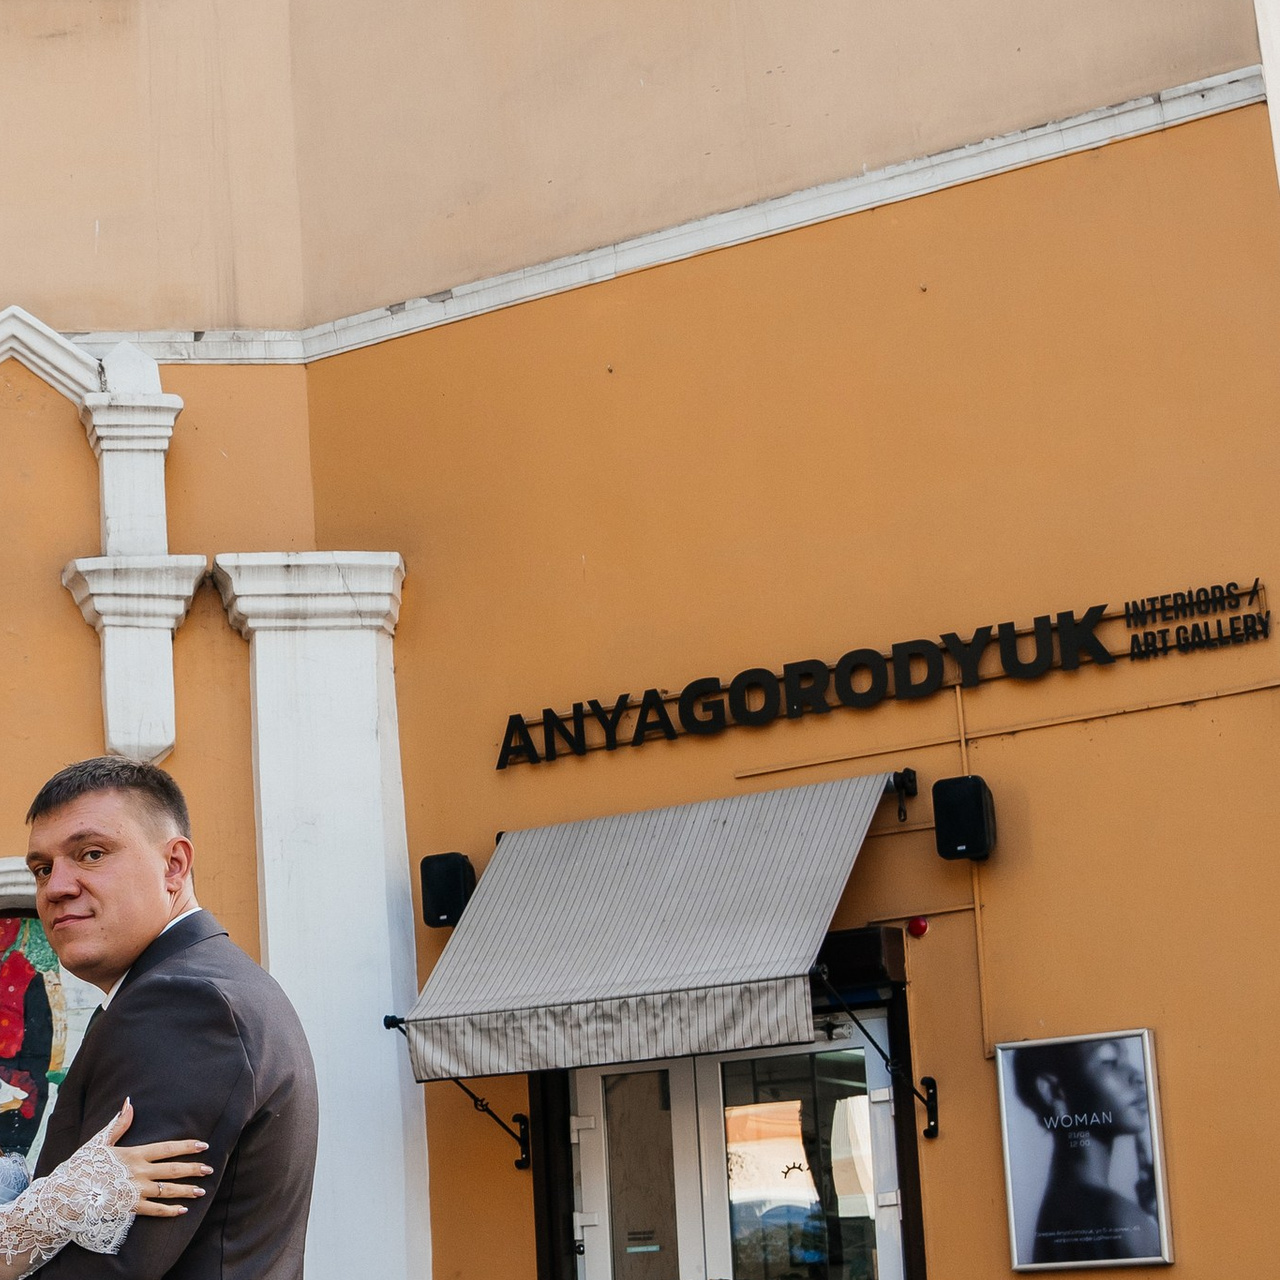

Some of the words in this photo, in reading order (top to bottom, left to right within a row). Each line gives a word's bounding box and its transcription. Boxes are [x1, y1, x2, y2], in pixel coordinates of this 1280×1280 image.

[1125, 582, 1240, 628] INTERIORS
[1130, 628, 1170, 661] ART
[1175, 610, 1270, 652] GALLERY
[496, 604, 1116, 770] ANYAGORODYUK
[1043, 1111, 1113, 1129] WOMAN
